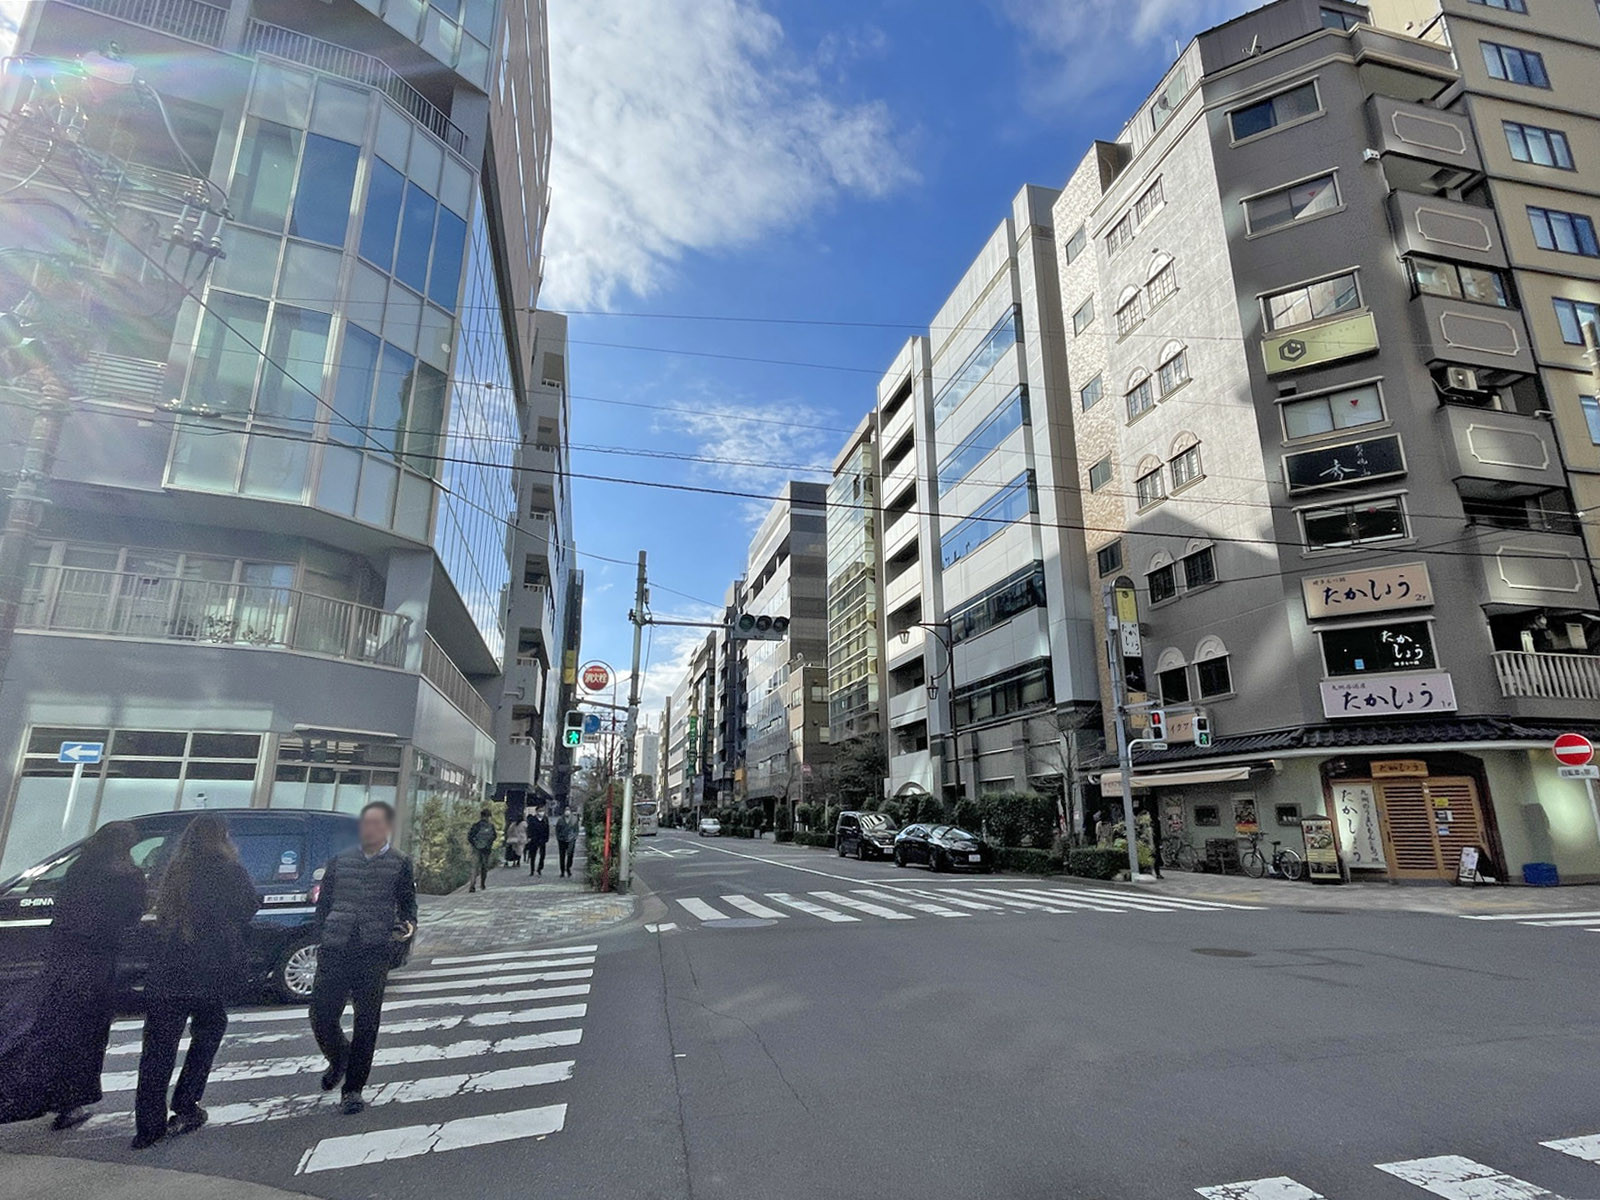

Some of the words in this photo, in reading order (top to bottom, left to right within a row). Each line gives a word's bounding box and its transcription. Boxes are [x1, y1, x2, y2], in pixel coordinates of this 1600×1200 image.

[1323, 574, 1411, 605] たかしょう
[1381, 630, 1413, 643] たか
[1393, 644, 1424, 660] しょう
[584, 672, 607, 683] 消火栓
[1342, 683, 1433, 710] たかしょう
